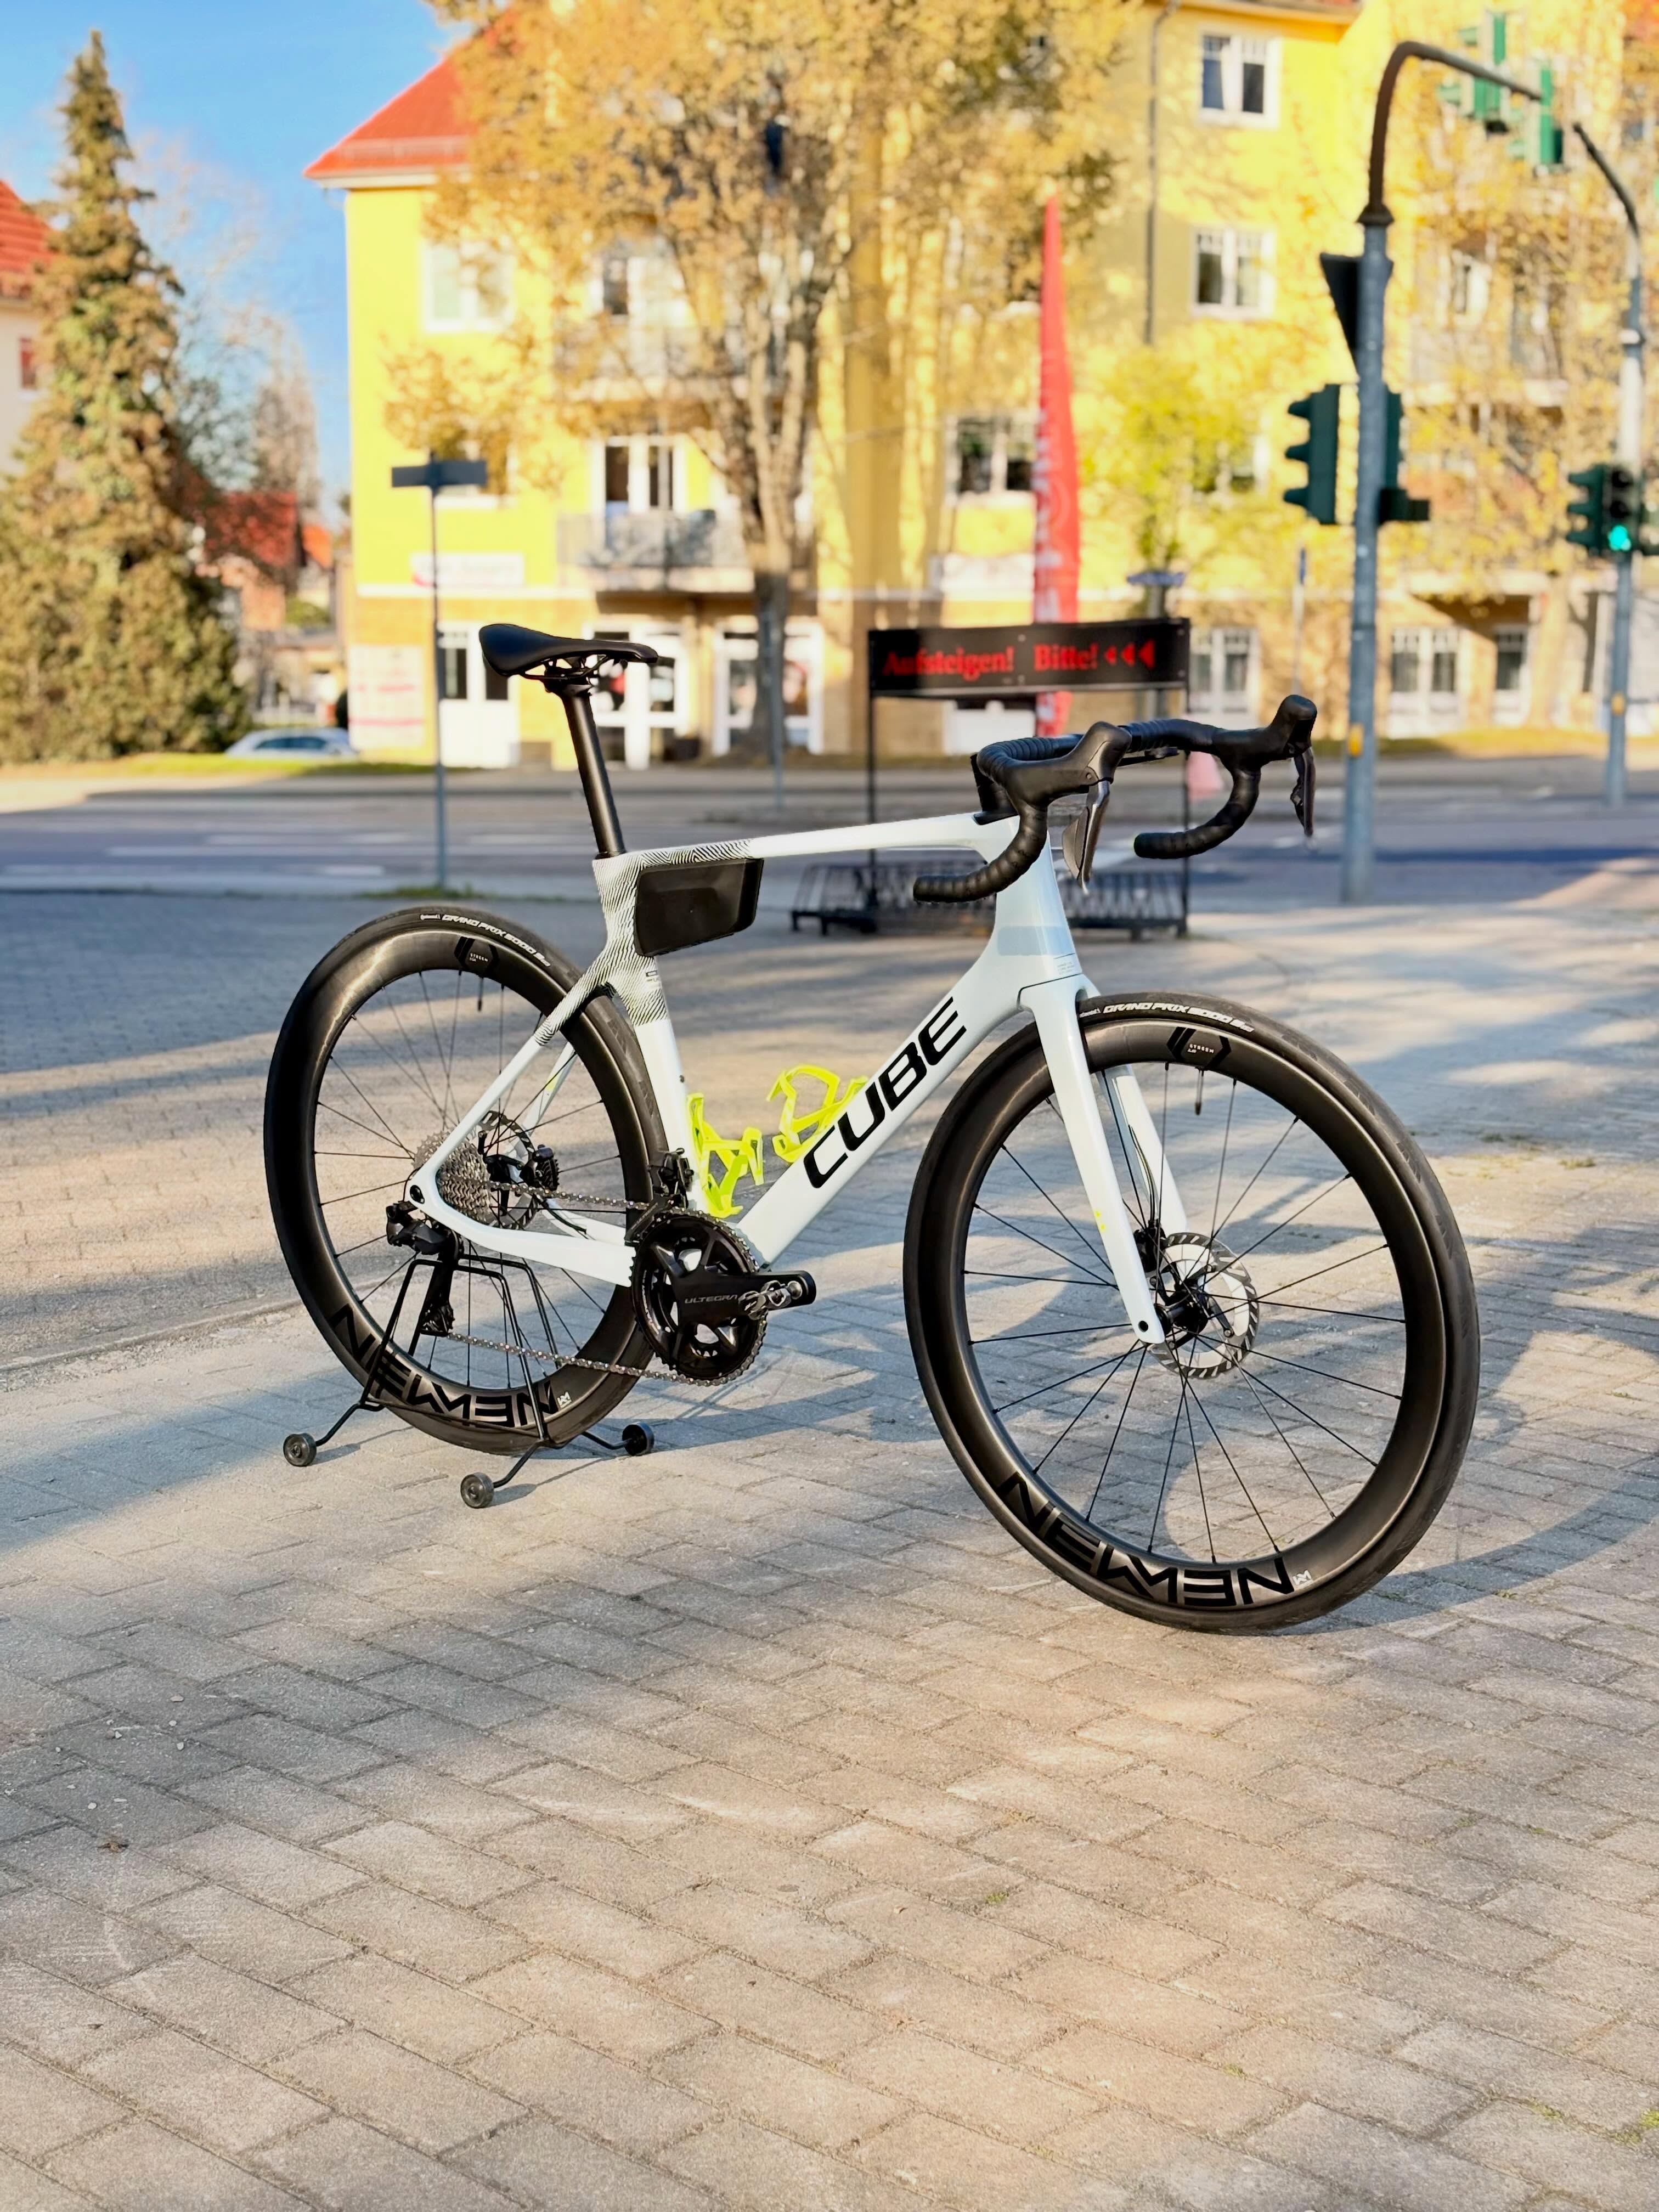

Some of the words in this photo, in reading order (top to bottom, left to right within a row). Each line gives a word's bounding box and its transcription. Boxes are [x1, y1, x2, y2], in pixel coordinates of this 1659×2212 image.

[883, 645, 1014, 682] Aufsteigen!
[1034, 641, 1099, 671] Bitte!
[442, 915, 480, 927] GRAND
[478, 922, 506, 936] PRIX
[1103, 1002, 1153, 1014] GRAND
[1152, 1002, 1189, 1013] PRIX
[803, 996, 967, 1188] CUBE
[684, 1294, 738, 1304] ULTEGRA
[997, 1471, 1295, 1607] NEWMEN
